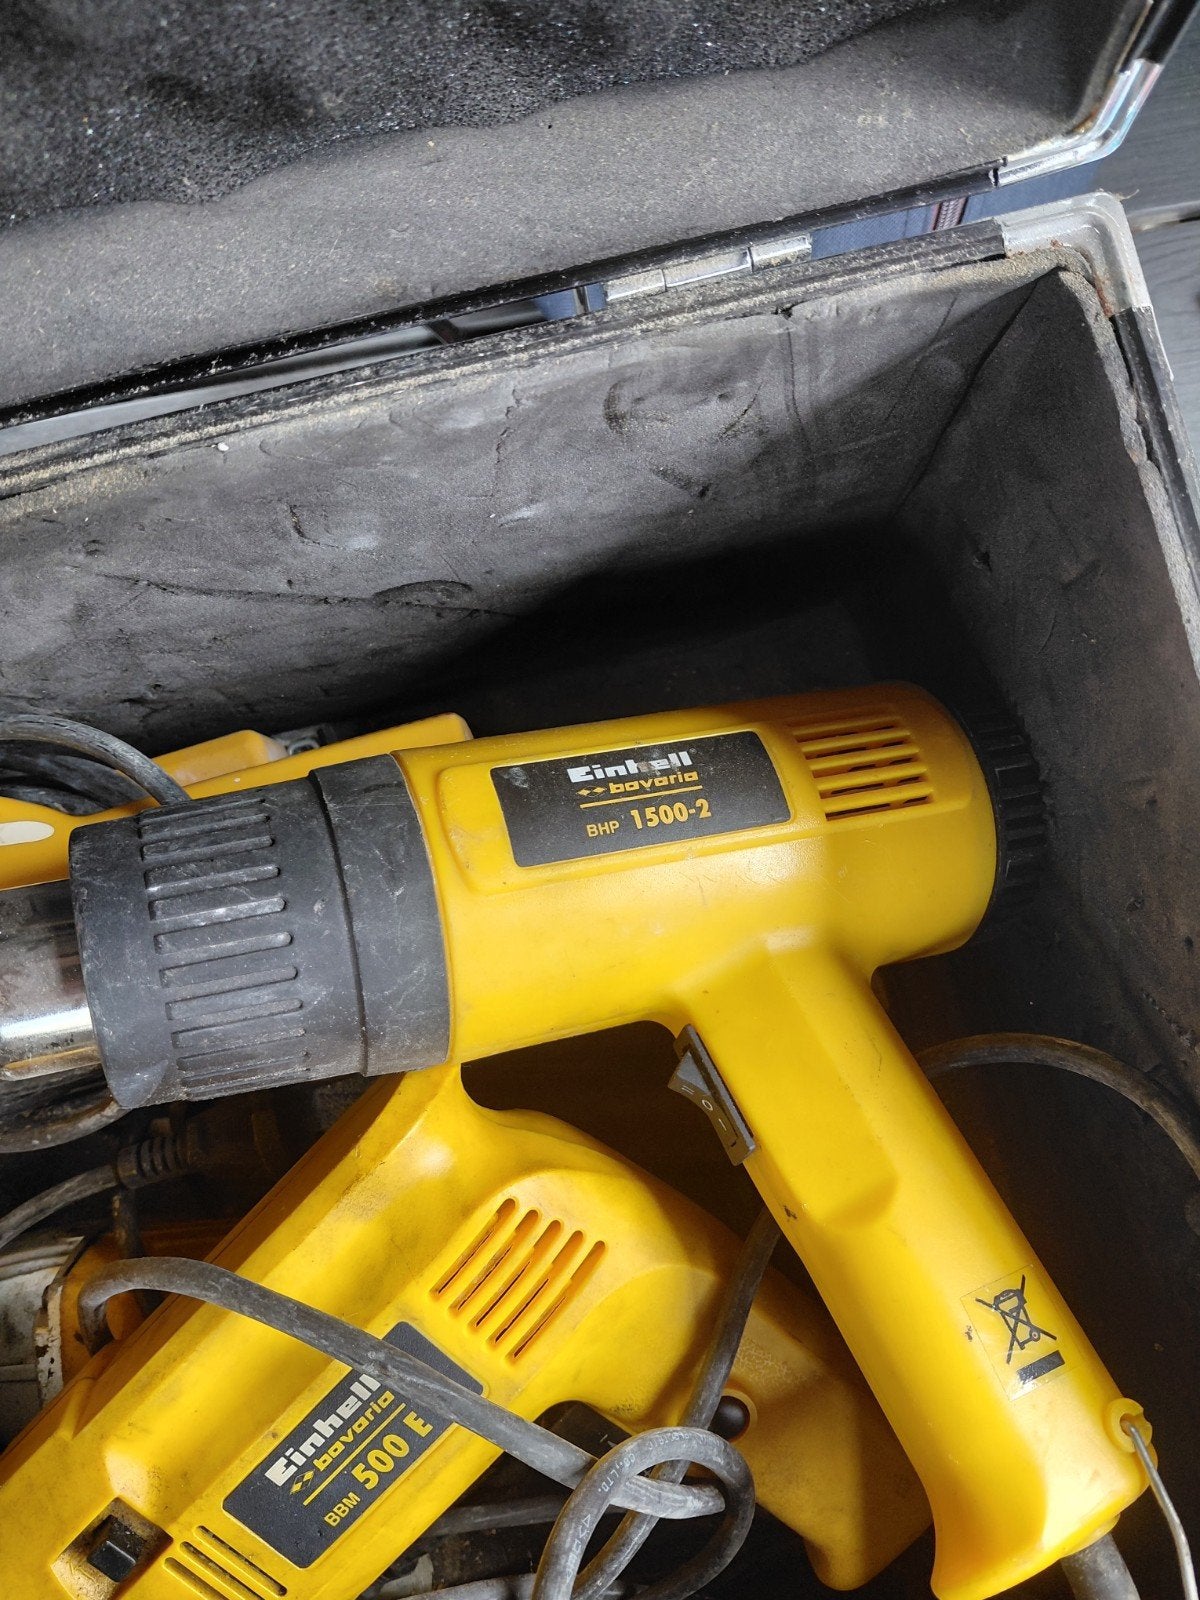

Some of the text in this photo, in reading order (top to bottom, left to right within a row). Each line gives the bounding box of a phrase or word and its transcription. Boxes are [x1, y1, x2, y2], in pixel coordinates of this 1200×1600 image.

[586, 799, 711, 838] BHP 1500-2
[609, 771, 699, 794] bavaria
[264, 1373, 382, 1487] Einhell
[312, 1390, 396, 1472] bavaria
[323, 1411, 434, 1527] BBM 500 E
